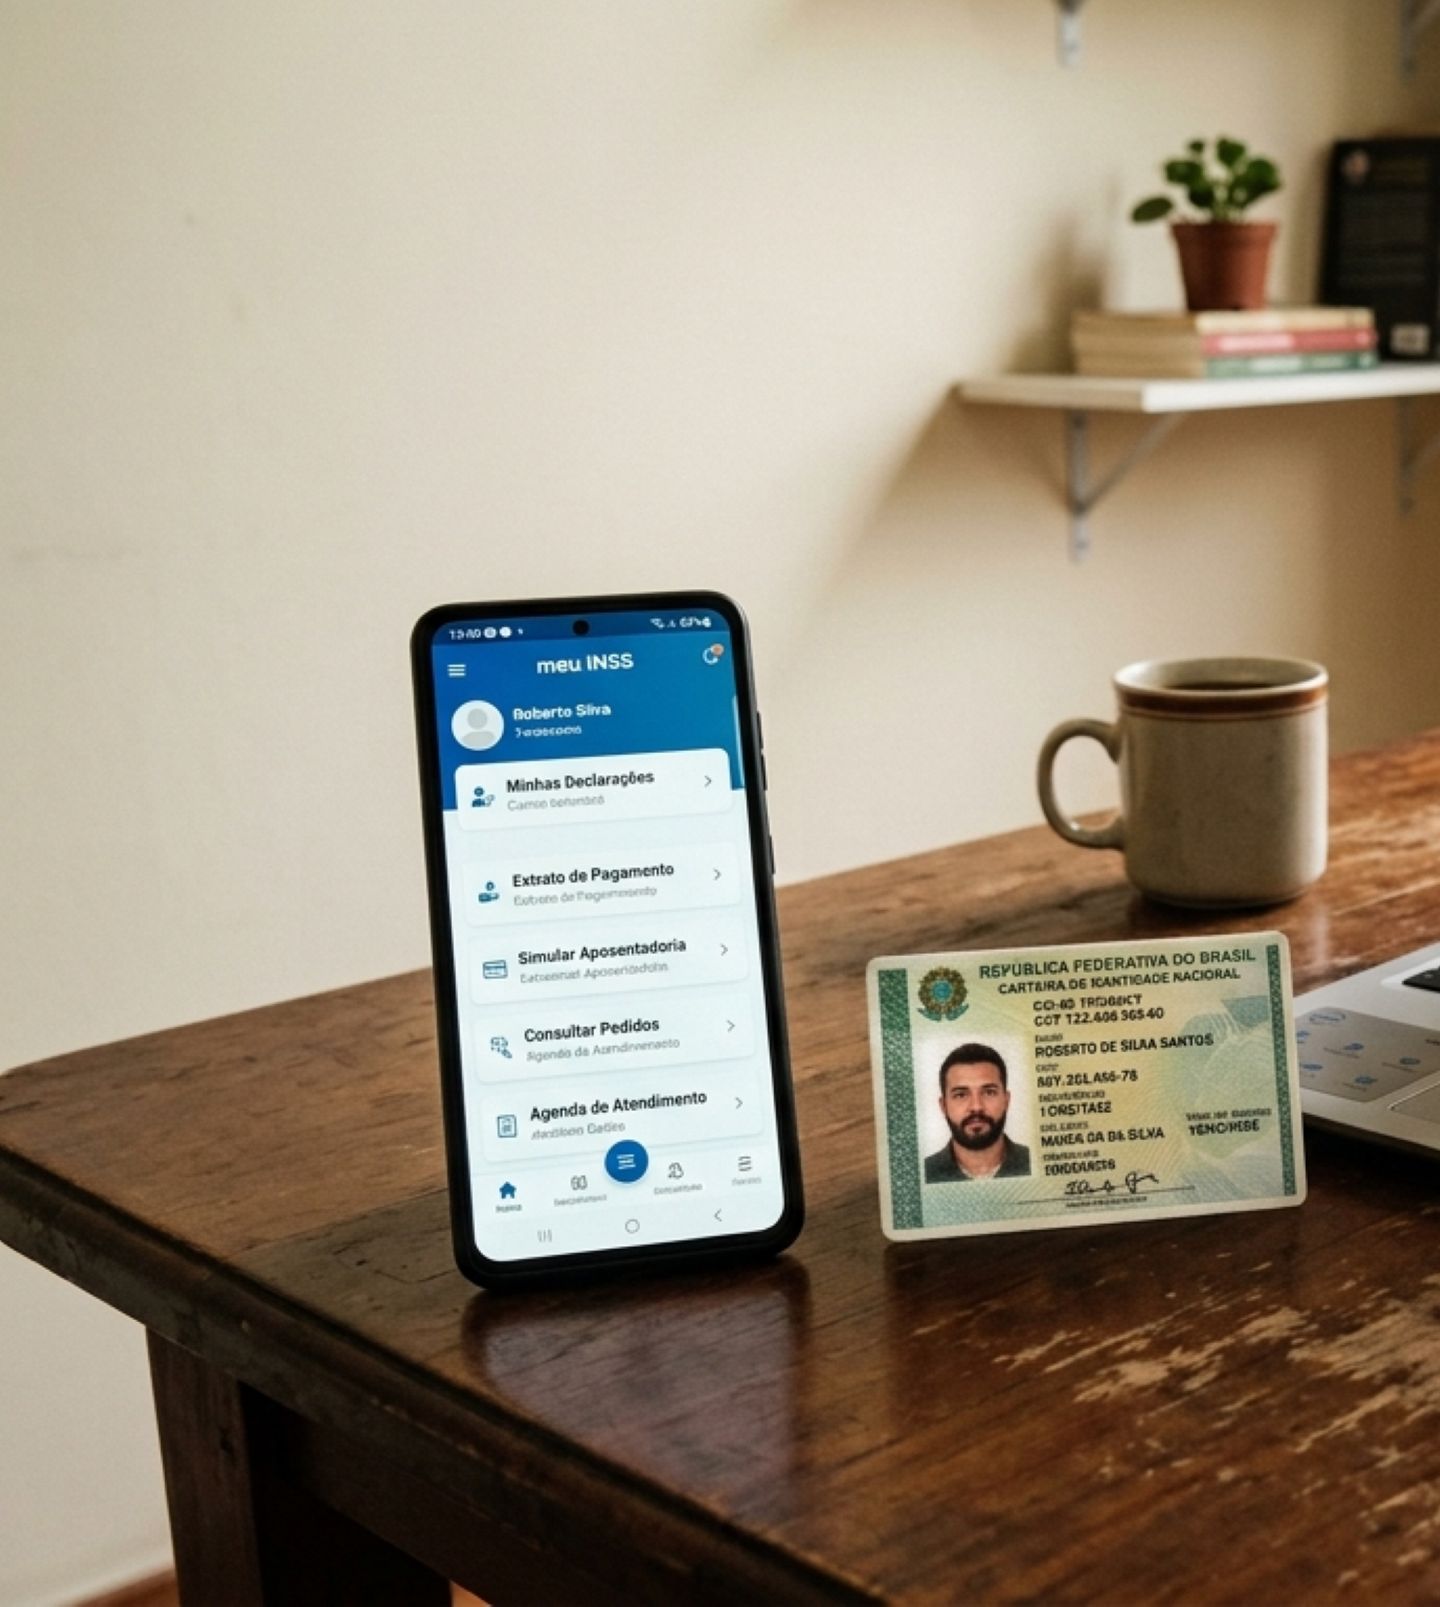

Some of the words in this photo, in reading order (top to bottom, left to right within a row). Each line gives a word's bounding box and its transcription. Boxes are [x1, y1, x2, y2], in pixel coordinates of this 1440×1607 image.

[536, 658, 582, 674] meu
[586, 653, 635, 672] INSS
[506, 776, 561, 794] Minhas
[564, 770, 656, 790] Declarações
[512, 871, 566, 888] Extrato
[568, 869, 588, 884] de
[591, 862, 675, 884] Pagamento
[518, 948, 576, 966] Simular
[579, 938, 687, 962] Aposentadoria
[1200, 948, 1257, 965] BRASIL
[524, 1023, 597, 1043] Consultar
[599, 1018, 660, 1036] Pedidos
[1160, 1032, 1215, 1050] SANTOS
[530, 1101, 588, 1124] Agenda
[591, 1099, 609, 1116] de
[612, 1091, 708, 1113] Atendimento
